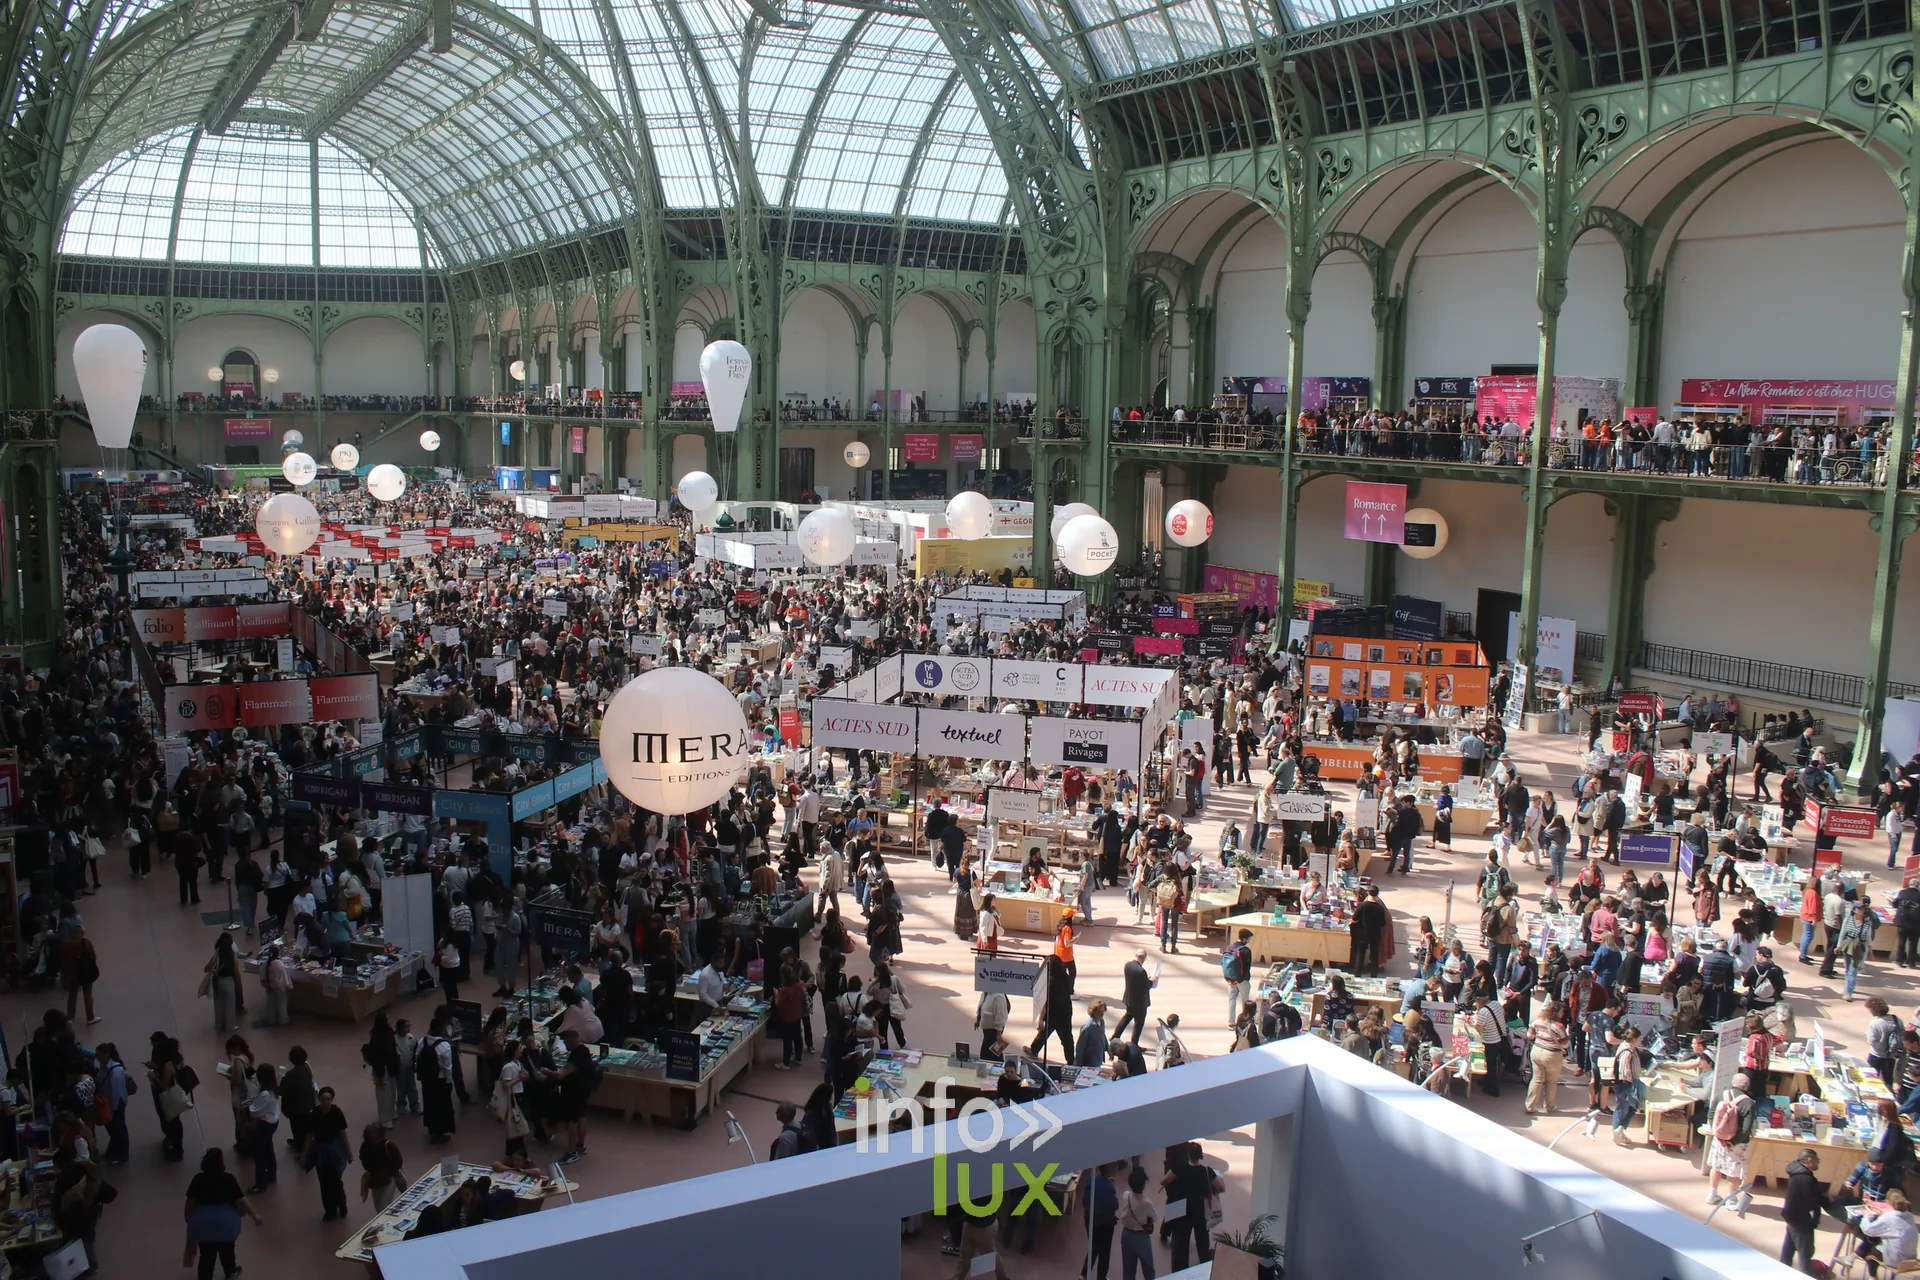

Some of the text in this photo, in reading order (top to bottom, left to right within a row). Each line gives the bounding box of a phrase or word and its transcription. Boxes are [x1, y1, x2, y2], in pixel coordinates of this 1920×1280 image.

[1760, 383, 1805, 398] Romance
[1855, 384, 1897, 399] HUG
[1354, 498, 1397, 512] Romance
[1013, 517, 1033, 525] GÉOR
[1090, 550, 1116, 558] POCKET
[1158, 606, 1174, 614] ZOE
[1395, 610, 1410, 622] Crif
[143, 617, 174, 634] folio
[189, 617, 235, 629] Gallimard
[242, 614, 287, 627] Gallimard
[956, 667, 976, 675] ACTES
[1091, 679, 1138, 693] ACTES
[245, 699, 306, 711] Flammarion
[316, 692, 374, 706] Flammarion
[821, 717, 910, 738] ACTES SUD
[940, 723, 1003, 747] textuel
[1069, 728, 1104, 740] PAYOT
[632, 728, 748, 763] MERA
[1082, 739, 1090, 748] &
[1067, 746, 1104, 759] Rivages
[668, 769, 732, 783] EDITIONS
[441, 800, 465, 812] City
[1289, 806, 1312, 814] LAFON
[1830, 815, 1871, 826] SciencesPo
[543, 922, 583, 938] MERA
[990, 970, 1035, 981] radiofrance
[1628, 1000, 1660, 1009] Sciences
[672, 1036, 695, 1046] MERA
